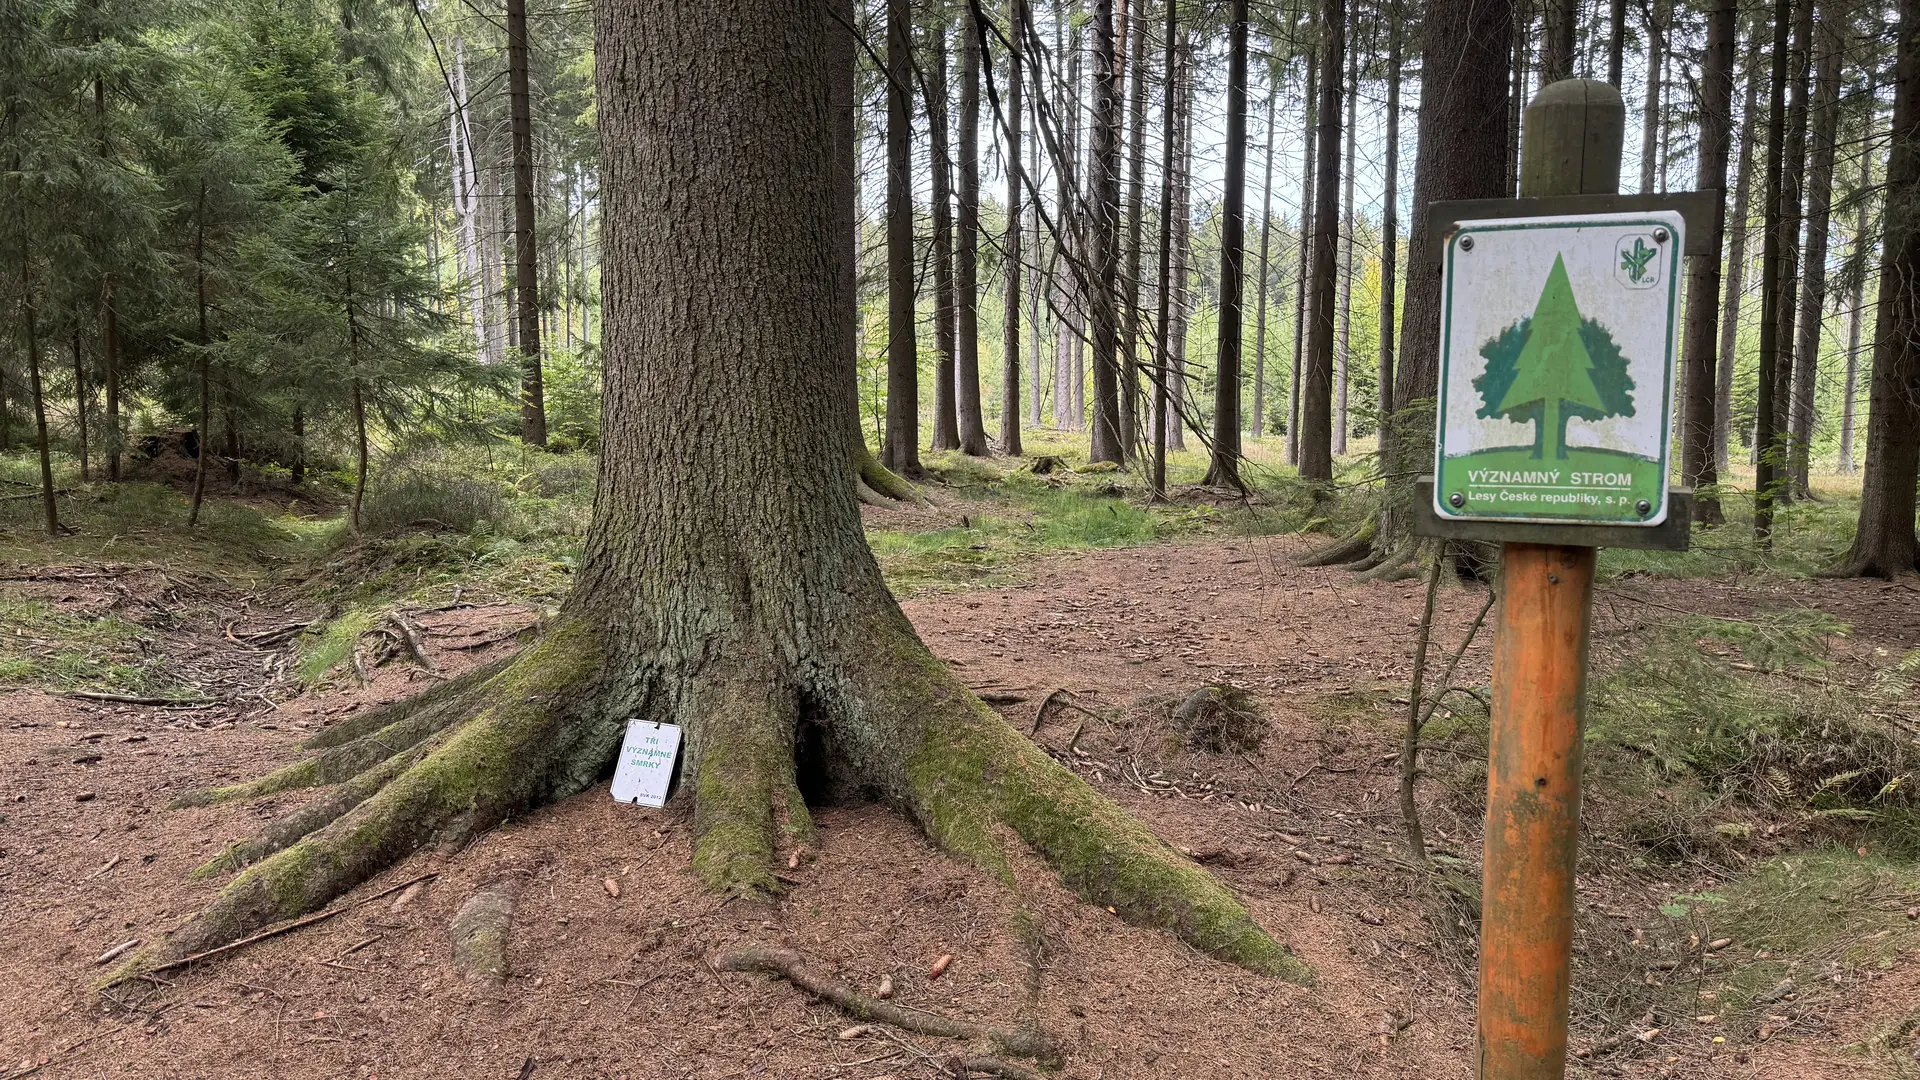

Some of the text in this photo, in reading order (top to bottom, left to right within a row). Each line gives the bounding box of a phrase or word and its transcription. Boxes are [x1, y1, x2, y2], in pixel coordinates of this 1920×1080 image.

[1468, 468, 1632, 486] VÝZNAMNÝ STROM
[1468, 489, 1631, 506] Lesy České republiky, s. p.
[630, 759, 661, 769] SMRKY
